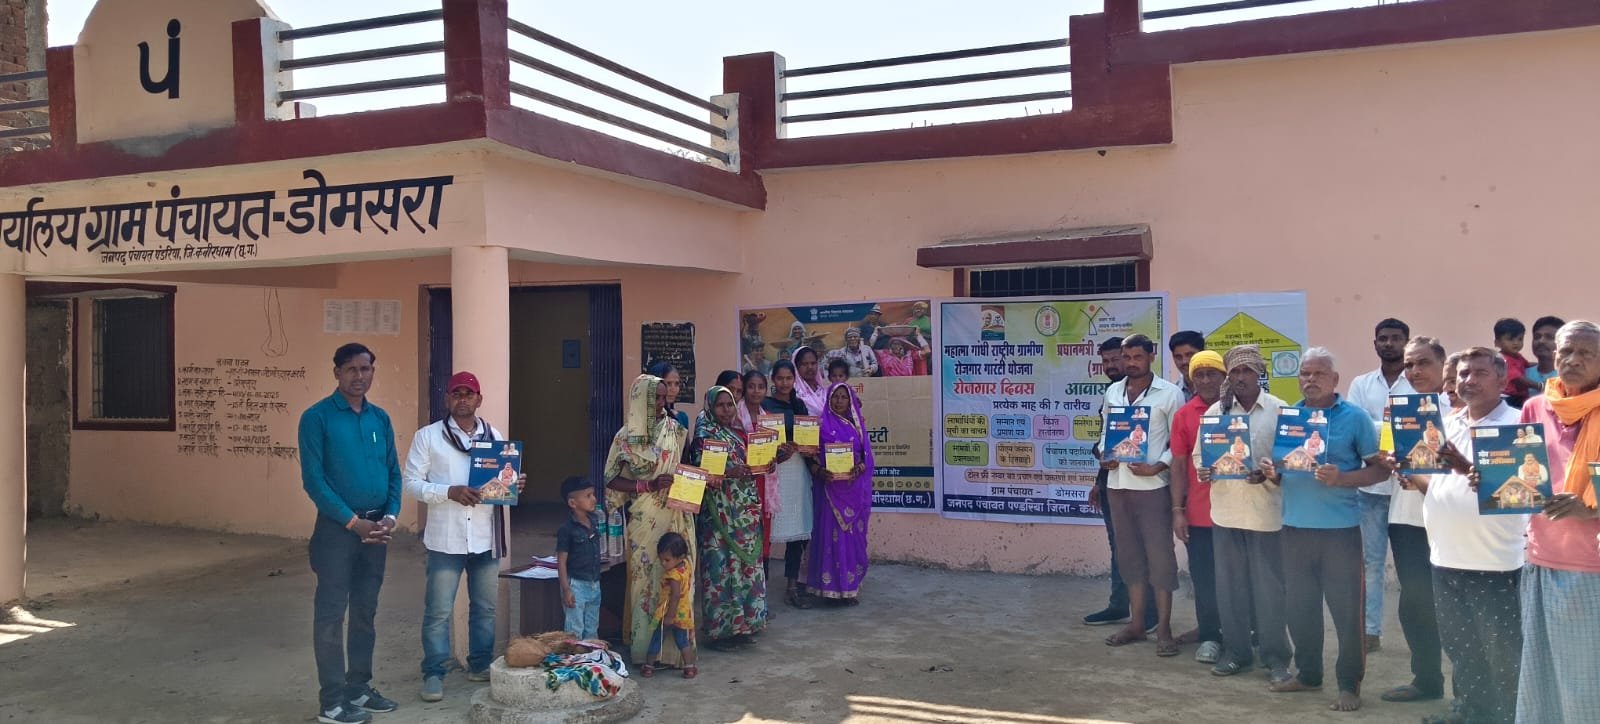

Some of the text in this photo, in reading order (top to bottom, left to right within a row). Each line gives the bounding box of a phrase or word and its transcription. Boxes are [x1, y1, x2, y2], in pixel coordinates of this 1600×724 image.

[137, 18, 181, 99] पं
[0, 197, 87, 256] र्यालय
[85, 201, 153, 252] ग्राम
[128, 246, 155, 263] पंचायत
[971, 340, 989, 359] गांधी
[991, 341, 1014, 360] राष्ट्रीय
[1017, 341, 1044, 359] ग्रामीण
[1057, 338, 1094, 357] प्रधानमंत्री
[954, 358, 1033, 375] रोजगार गारंटी योजना
[953, 377, 1035, 396] रोजगार दिवस
[993, 398, 1018, 410] प्रत्येक
[1021, 400, 1036, 411] माह
[1039, 398, 1050, 410] की
[1063, 399, 1090, 410] तारीख
[977, 416, 985, 425] की
[991, 486, 1006, 496] ग्राम
[1007, 484, 1033, 496] पंचायत
[1055, 488, 1086, 498] डोमसरा
[947, 499, 973, 510] जनपद
[977, 496, 1005, 511] पंचायत
[1008, 498, 1044, 514] पण्डरिया
